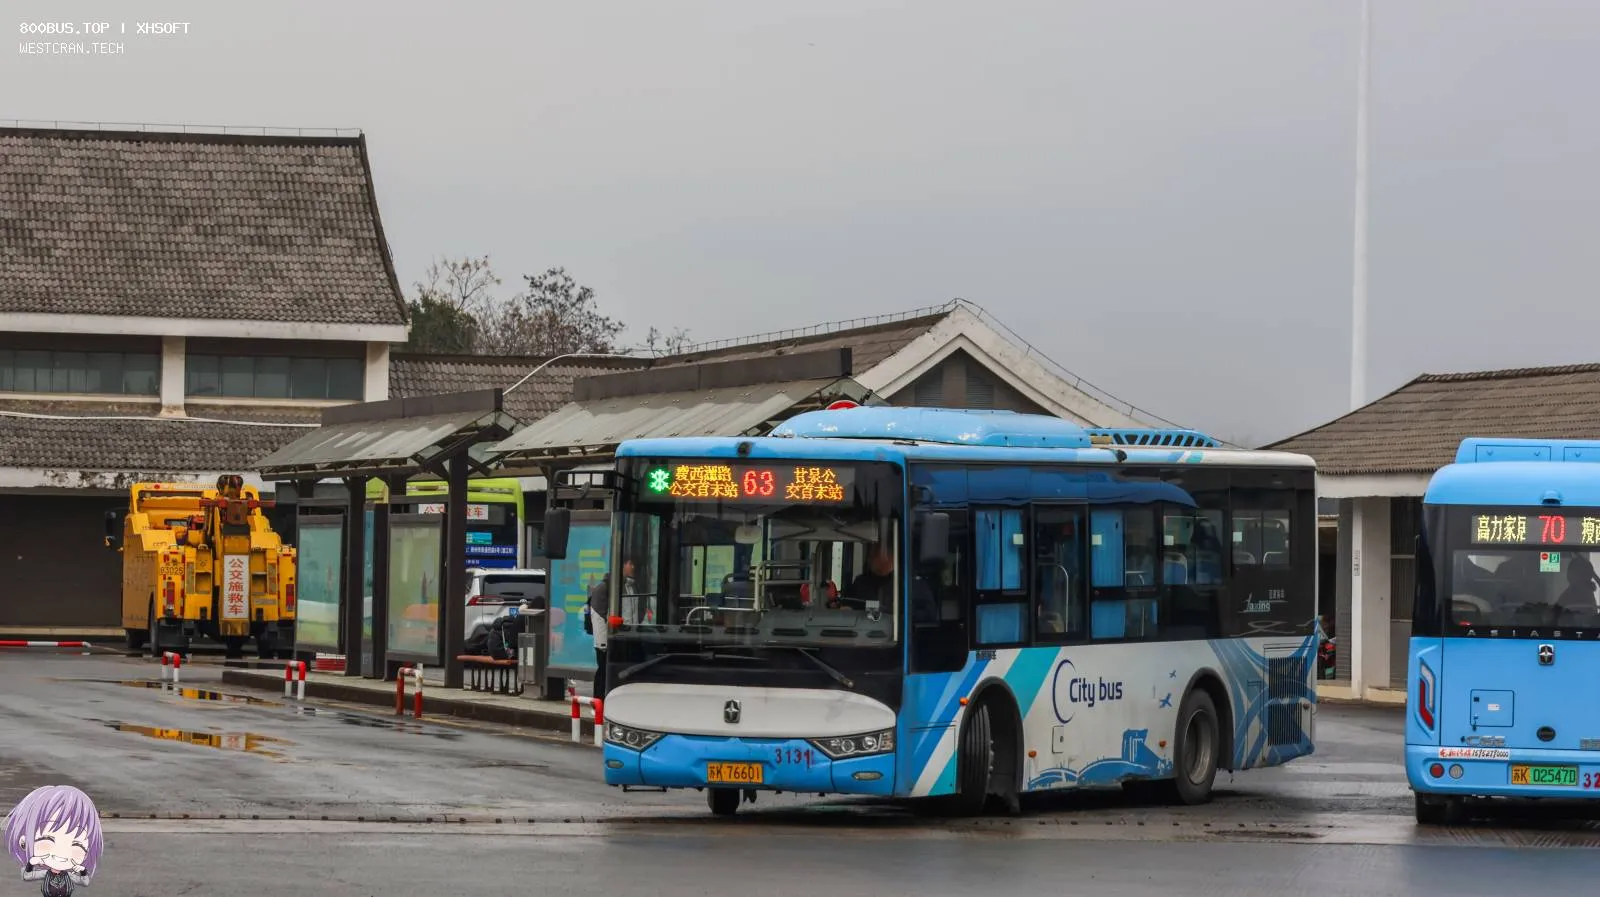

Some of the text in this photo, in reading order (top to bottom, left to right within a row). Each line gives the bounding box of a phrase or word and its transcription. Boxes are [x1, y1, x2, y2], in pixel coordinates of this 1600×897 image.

[743, 470, 774, 496] 63
[793, 468, 836, 484] 甘泉公
[671, 481, 739, 497] 公交首末站
[785, 483, 844, 500] 交首末站
[1538, 514, 1567, 544] 70
[228, 558, 244, 615] 公交施救车
[1467, 629, 1600, 639] ASIAST
[1070, 676, 1123, 708] City bus
